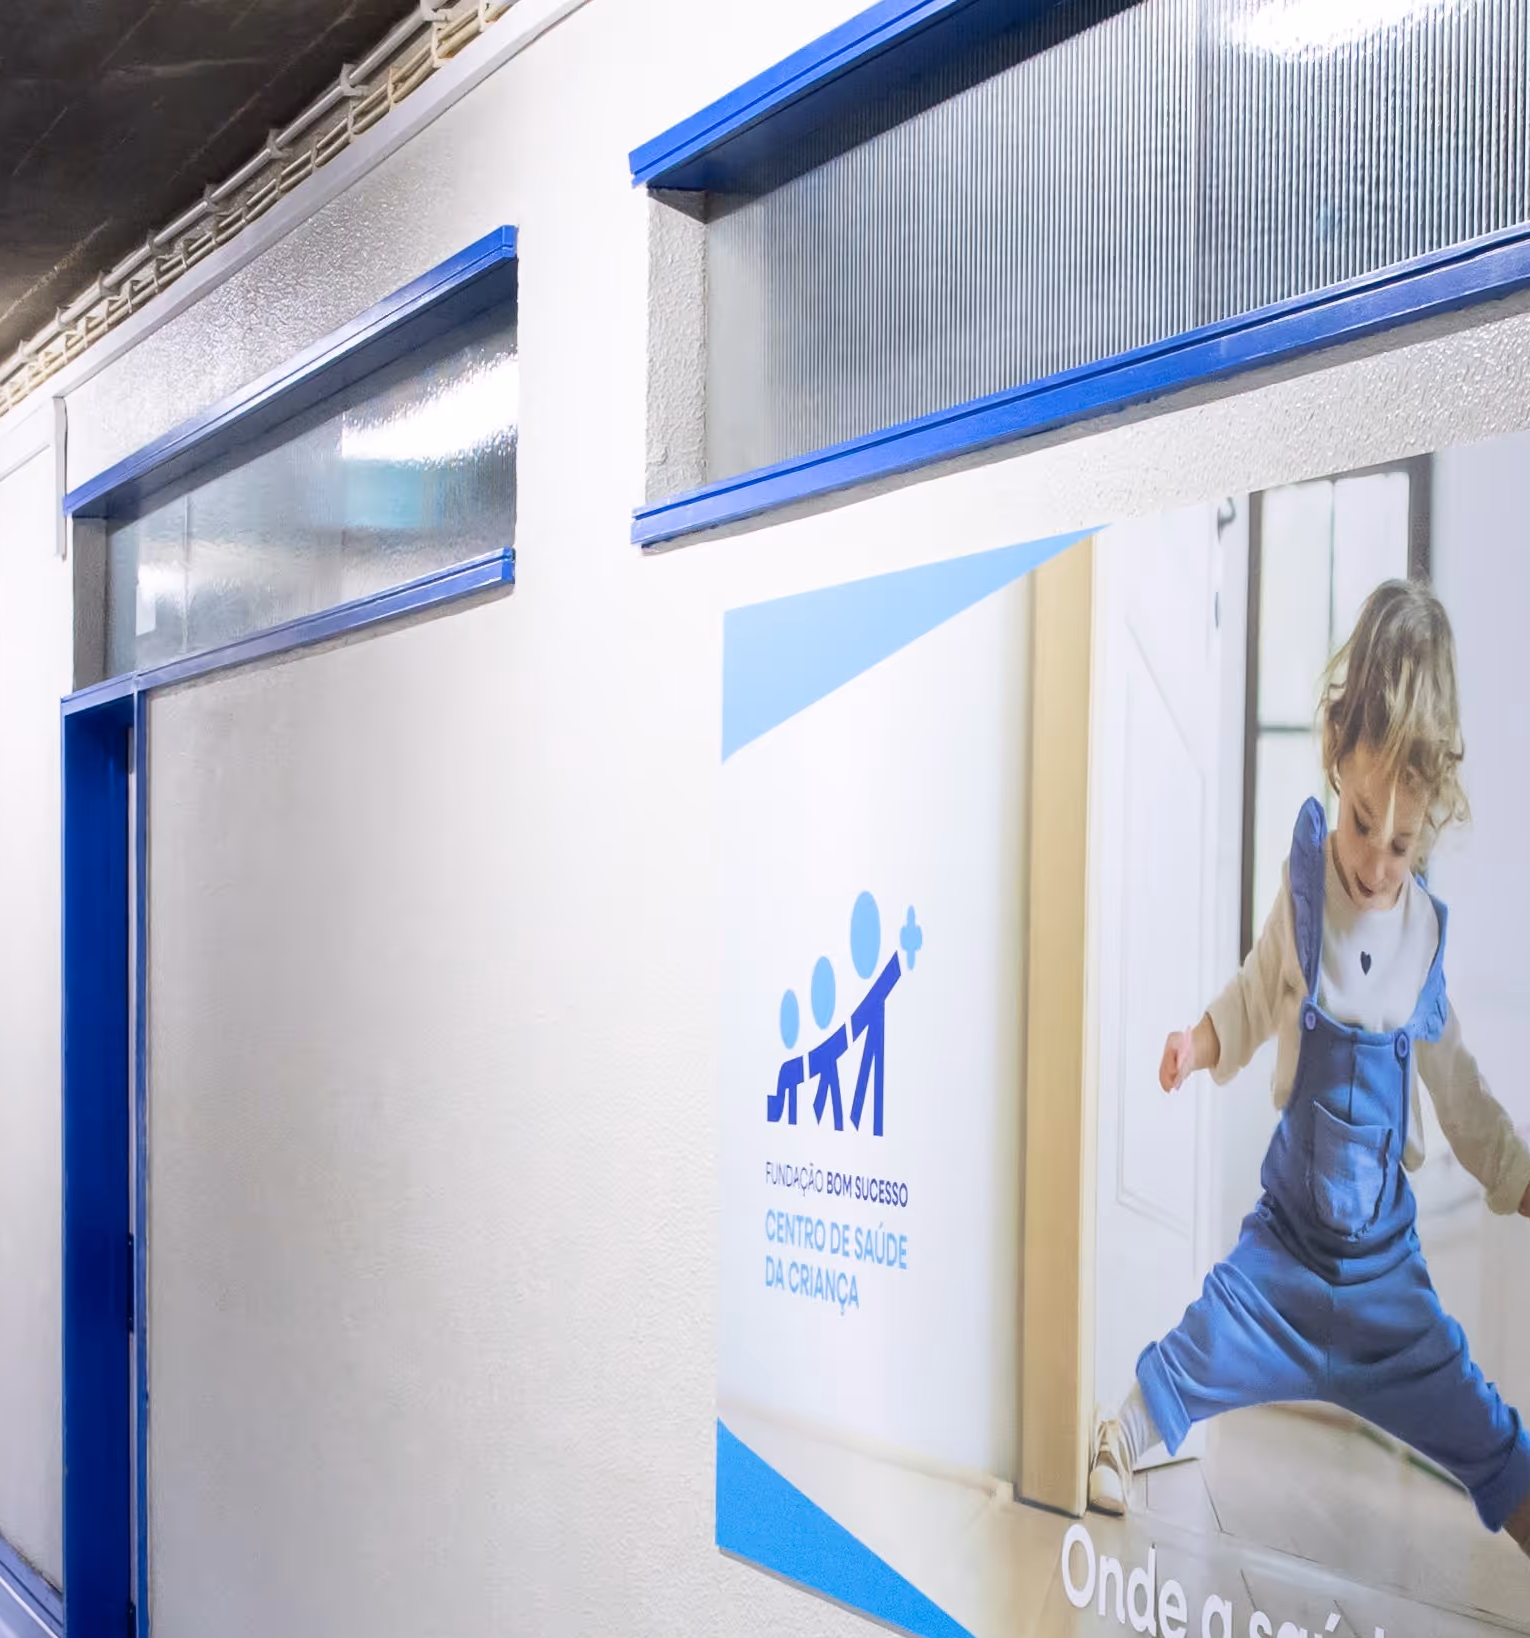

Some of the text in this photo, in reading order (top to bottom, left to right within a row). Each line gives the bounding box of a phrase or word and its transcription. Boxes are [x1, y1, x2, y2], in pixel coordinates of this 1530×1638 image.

[766, 1161, 908, 1208] FUNDAÇÃO BOM SUCESSO
[765, 1209, 908, 1269] CENTRO DE SAÚDE
[765, 1255, 859, 1316] DA CRIANÇA
